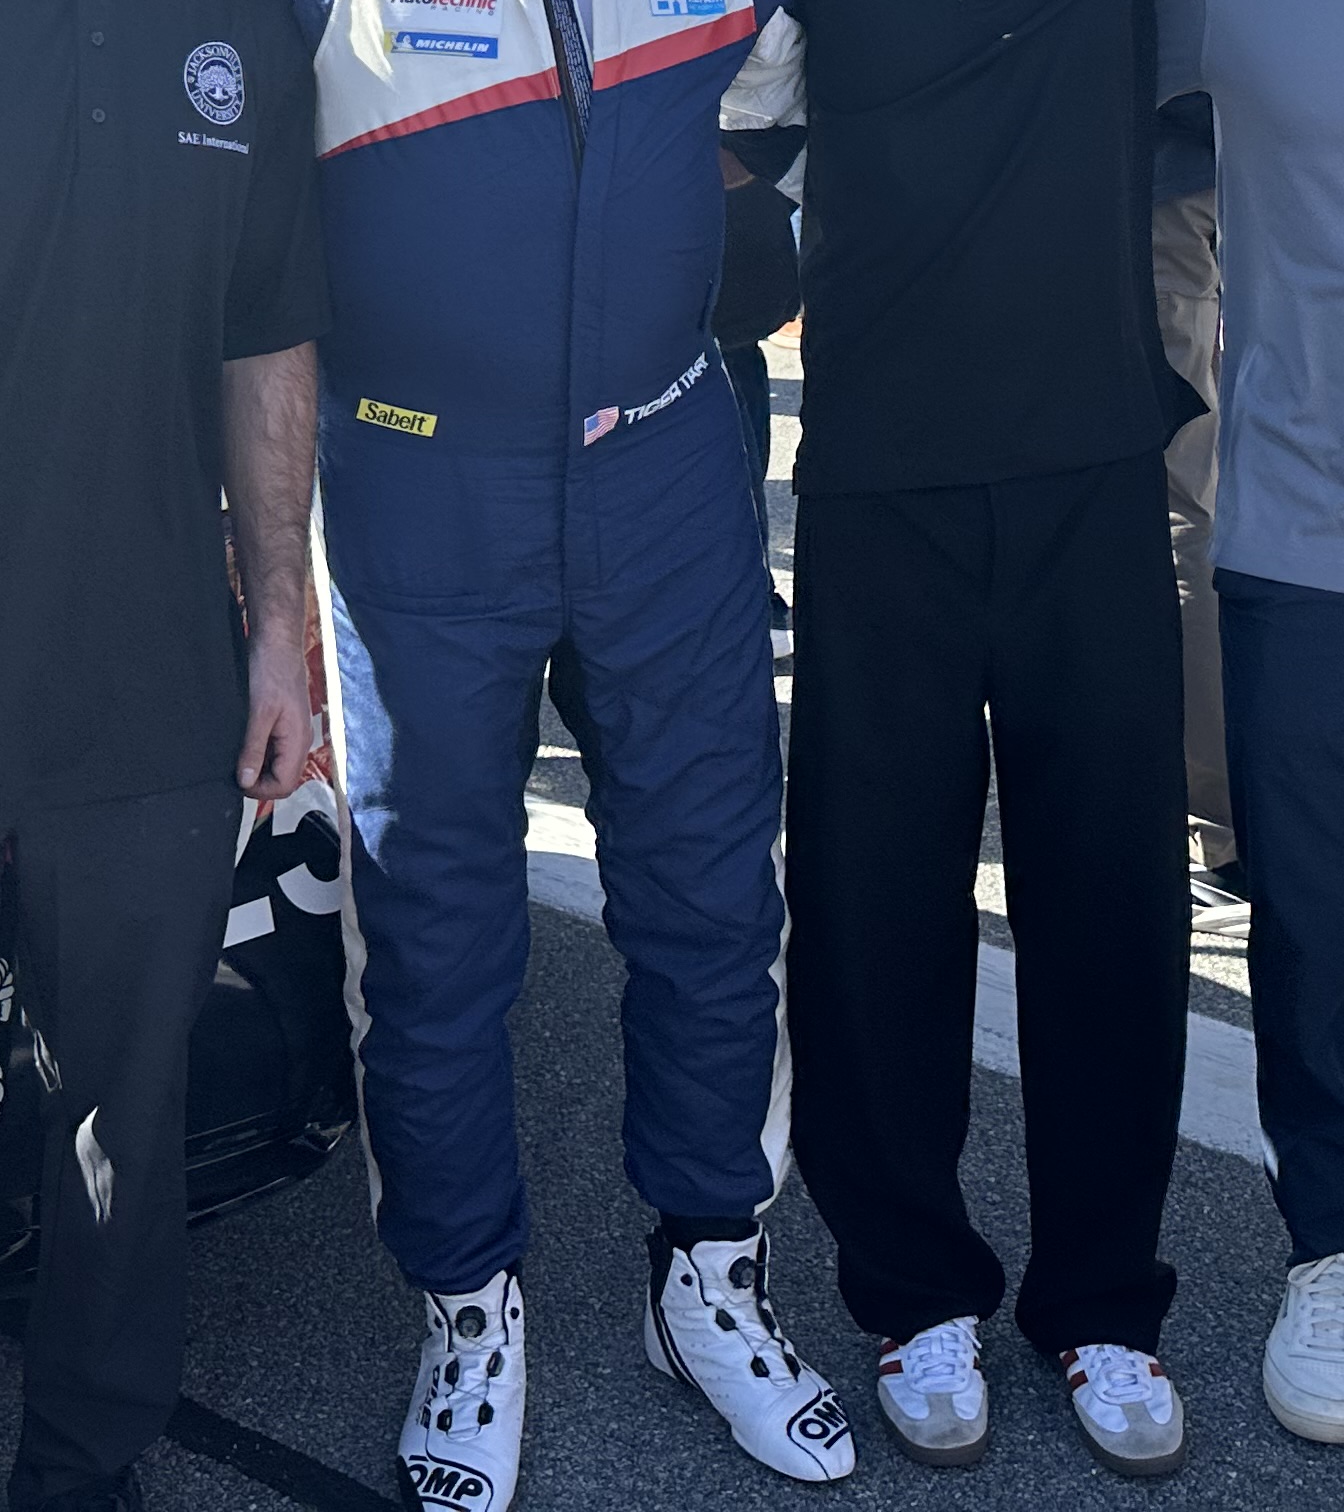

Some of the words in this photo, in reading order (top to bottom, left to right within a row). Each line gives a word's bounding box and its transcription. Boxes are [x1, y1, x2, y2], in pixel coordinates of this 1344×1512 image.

[430, 4, 495, 17] RACING
[416, 39, 490, 53] MICHELIN
[178, 131, 202, 144] SAE
[202, 133, 250, 155] International
[624, 381, 682, 424] TIGER
[364, 401, 427, 433] Sabelt
